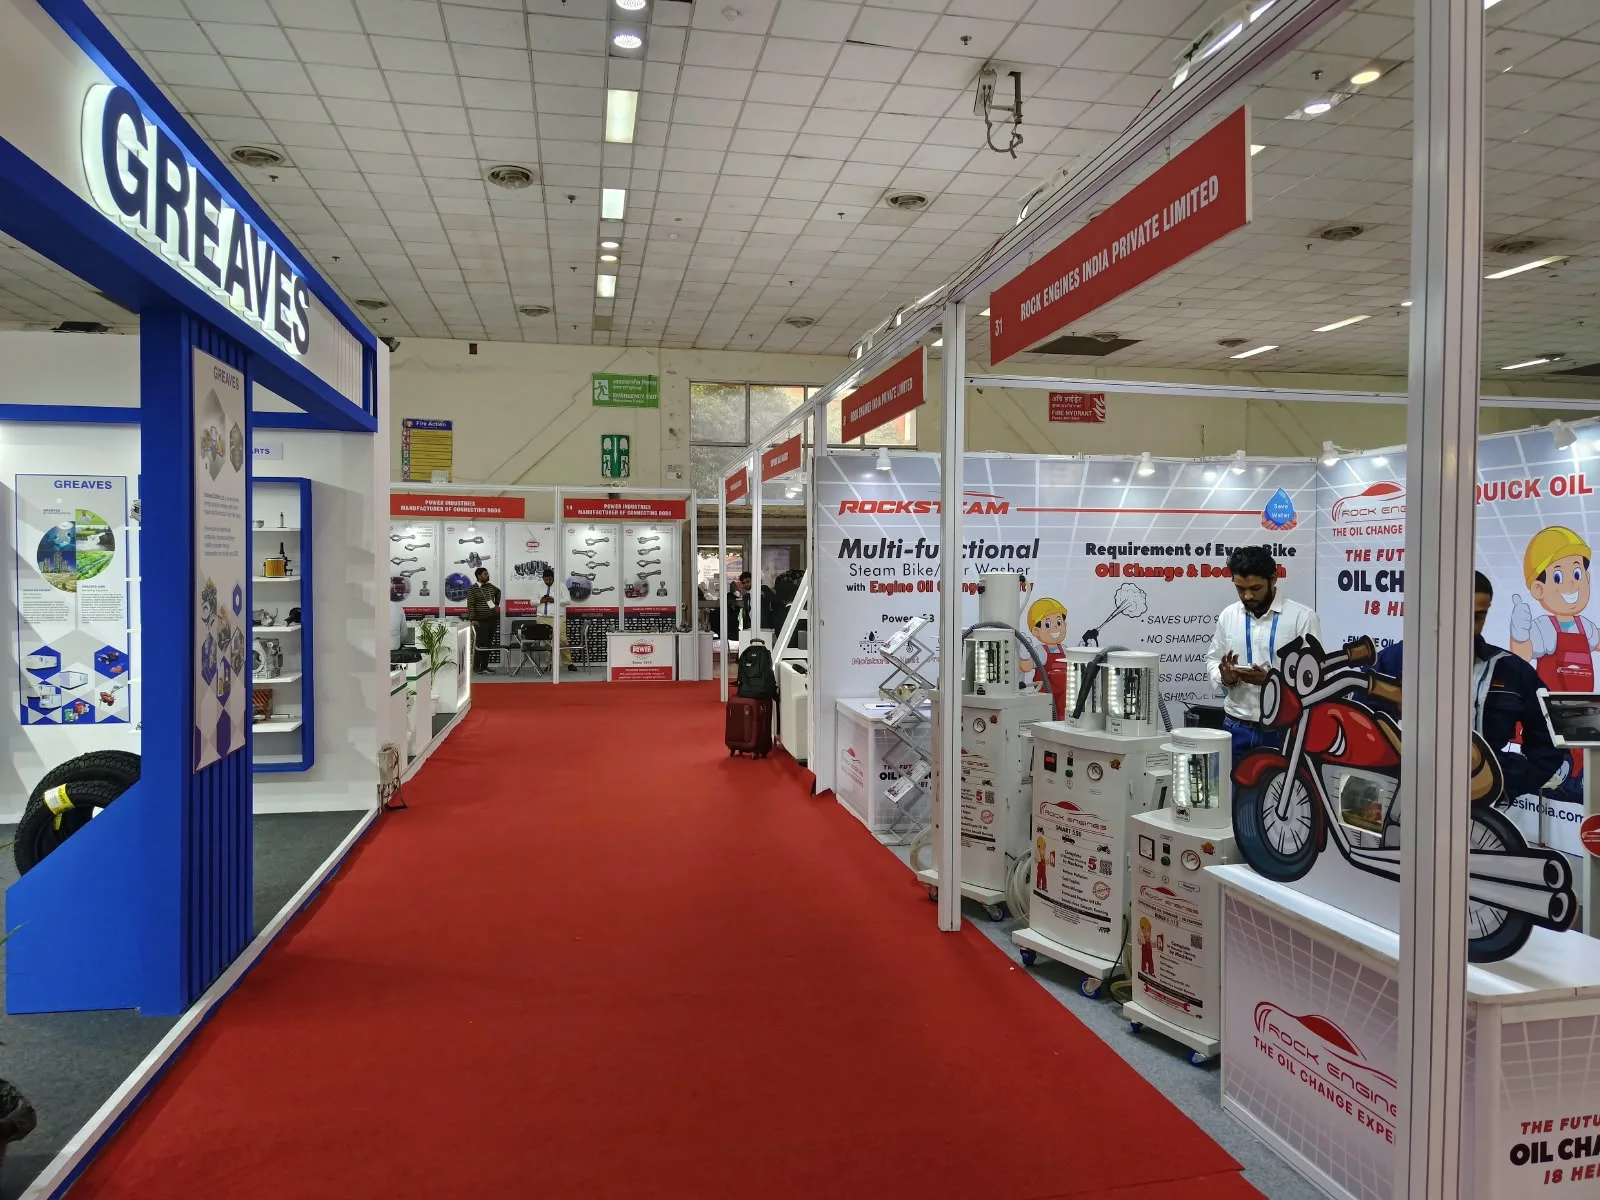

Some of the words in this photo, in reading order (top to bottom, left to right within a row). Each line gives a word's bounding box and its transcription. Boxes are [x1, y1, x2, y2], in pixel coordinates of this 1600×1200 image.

[100, 85, 310, 355] GREAVES
[994, 317, 1003, 336] 31
[1020, 296, 1042, 321] ROCK
[1043, 268, 1080, 307] ENGINES
[1082, 249, 1110, 283] INDIA
[1112, 214, 1160, 264] PRIVATE
[1163, 175, 1219, 231] LIMITED
[213, 366, 240, 391] GREAVES
[54, 480, 112, 490] GREAVES
[1549, 474, 1593, 497] OIL
[838, 500, 1010, 515] ROCKSTAM
[1342, 508, 1376, 517] ROCK
[1332, 528, 1347, 536] THE
[1349, 528, 1363, 536] OIL
[1366, 525, 1402, 536] CHANGE
[838, 538, 1040, 559] Multi-futional
[1086, 542, 1190, 559] Requirement
[1195, 543, 1212, 556] of
[1345, 550, 1371, 562] THE
[1376, 548, 1405, 562] FUT
[849, 563, 896, 576] Steam
[903, 563, 969, 577] Bike/r
[1095, 563, 1120, 578] Oil
[1123, 563, 1184, 582] Change
[1186, 564, 1198, 578] &
[1201, 564, 1232, 578] Bod
[846, 583, 866, 592] with
[870, 581, 914, 596] Engine
[917, 581, 934, 593] Oil
[1338, 570, 1372, 592] OIL
[1375, 570, 1404, 592] CH
[1364, 600, 1380, 615] IS
[1147, 615, 1181, 624] SAVES
[1184, 615, 1212, 624] UPTO
[1147, 635, 1162, 644] NO
[1175, 672, 1209, 682] SPACE
[879, 772, 898, 780] OIL
[1045, 810, 1064, 820] ROCK
[1512, 798, 1584, 824] esindia.com
[1056, 824, 1071, 835] SMART
[1088, 858, 1097, 870] 5
[1268, 1022, 1320, 1066] ROCK
[1253, 1036, 1274, 1060] THE
[1277, 1053, 1296, 1077] OIL
[1300, 1069, 1353, 1116] CHANGE
[1357, 1109, 1396, 1146] EXPE
[1521, 1120, 1553, 1135] THE
[1510, 1141, 1554, 1166] OIL
[1544, 1169, 1563, 1184] IS
